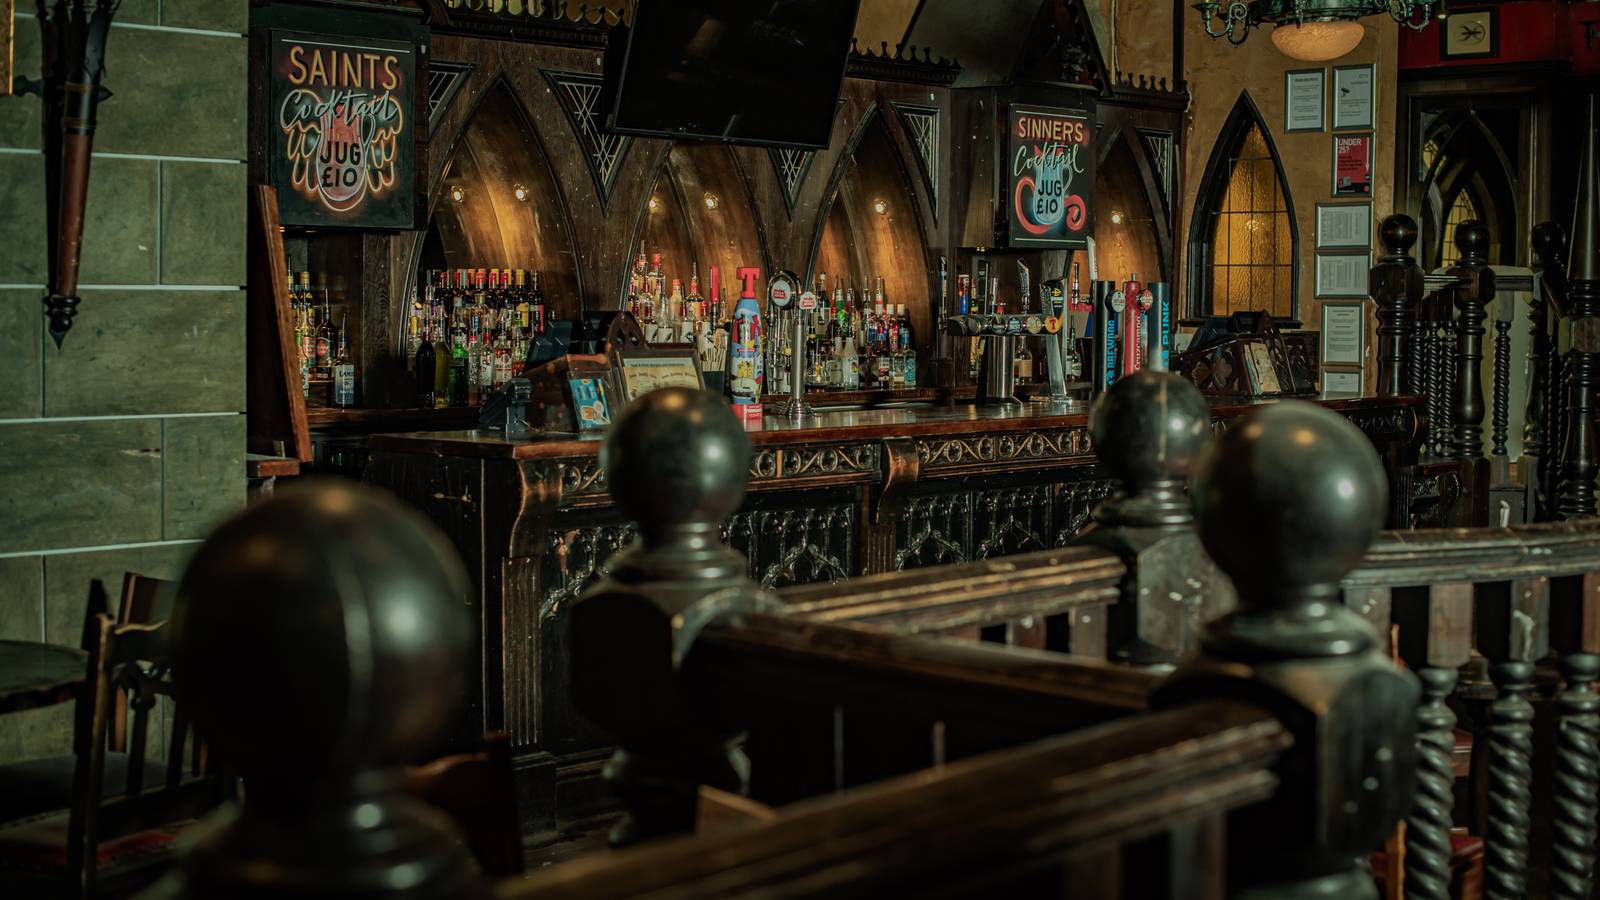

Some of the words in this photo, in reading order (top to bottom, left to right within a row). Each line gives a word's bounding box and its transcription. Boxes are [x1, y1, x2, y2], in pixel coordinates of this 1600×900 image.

[288, 46, 398, 90] SAINTS
[280, 88, 399, 129] Cocktail
[1018, 117, 1083, 142] SINNERS
[320, 141, 360, 164] JUG
[1338, 138, 1361, 147] UNDER
[1014, 141, 1084, 176] Cocktail
[322, 167, 357, 188] £10
[1038, 179, 1061, 197] JUG
[1037, 199, 1058, 215] £10
[1107, 320, 1115, 368] BREWDOG
